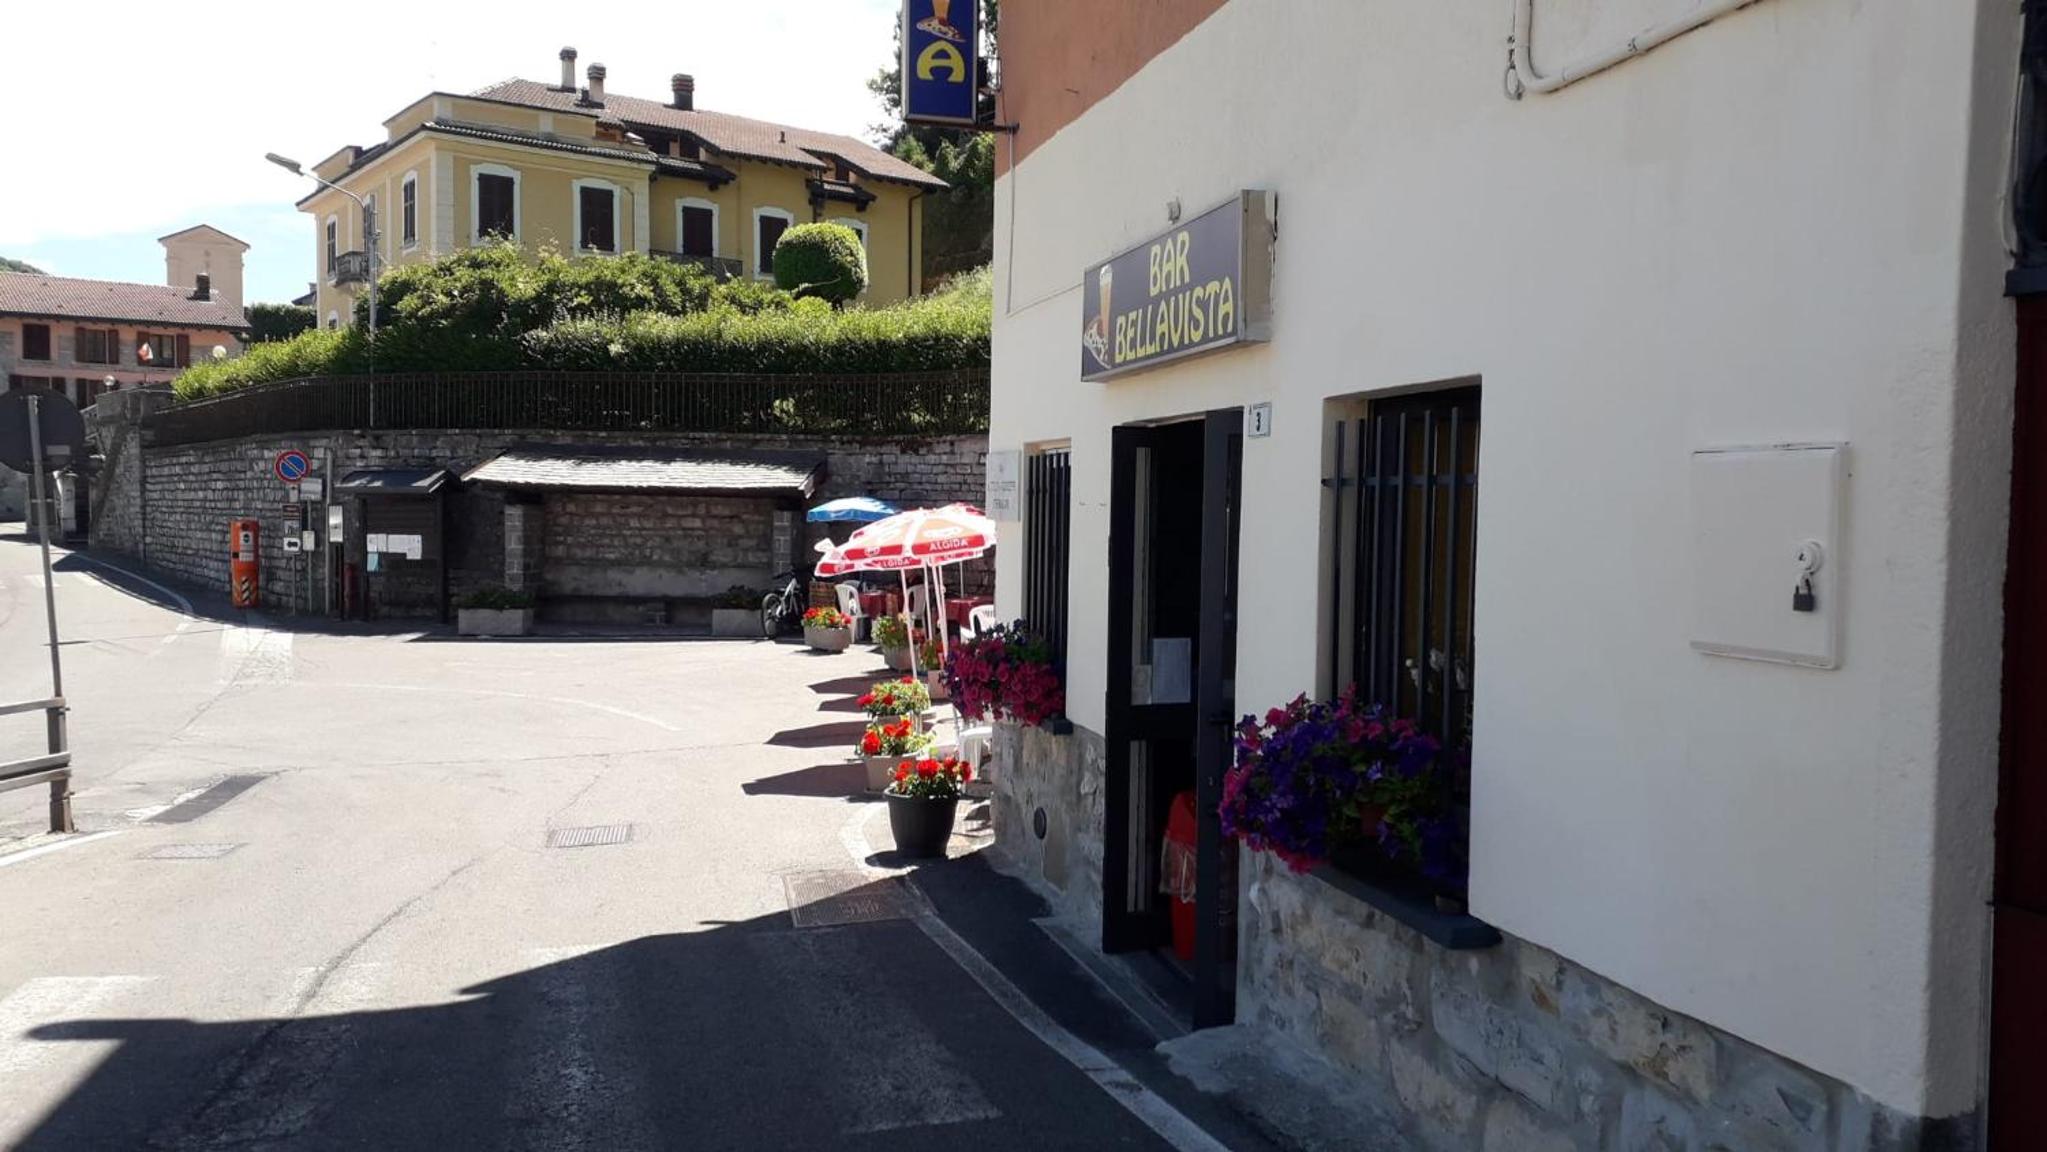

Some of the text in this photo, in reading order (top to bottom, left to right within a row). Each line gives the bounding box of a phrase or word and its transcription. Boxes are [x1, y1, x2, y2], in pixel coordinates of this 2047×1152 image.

[917, 40, 965, 82] A
[1150, 231, 1190, 297] BAR
[1115, 276, 1234, 363] BELLAVISTA
[1255, 411, 1262, 432] 3
[929, 538, 969, 551] ALGIDA
